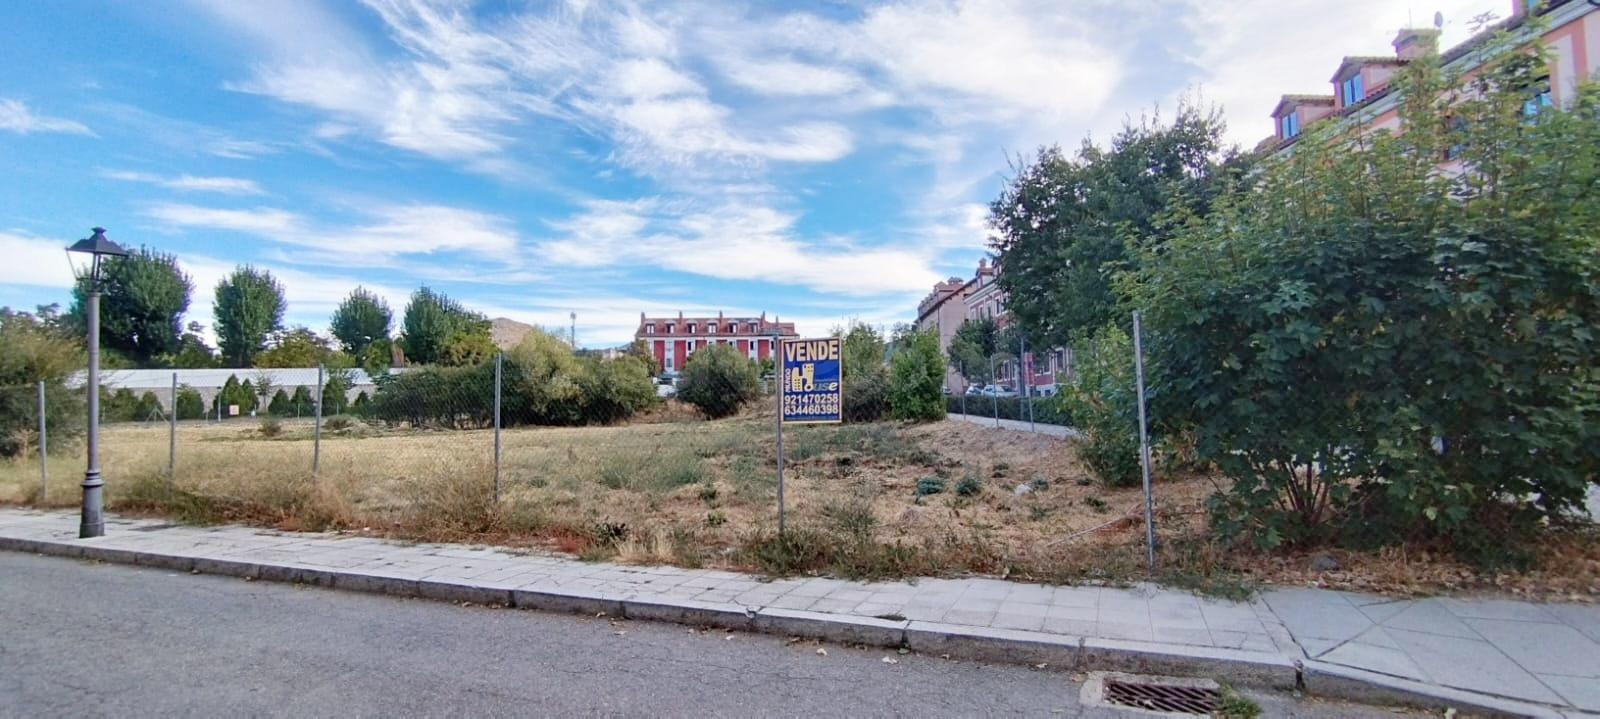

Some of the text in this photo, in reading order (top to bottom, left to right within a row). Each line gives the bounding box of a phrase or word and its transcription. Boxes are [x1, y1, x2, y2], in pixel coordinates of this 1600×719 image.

[785, 341, 838, 362] VENDE
[784, 393, 838, 405] 921470258
[784, 404, 838, 415] 634460398
